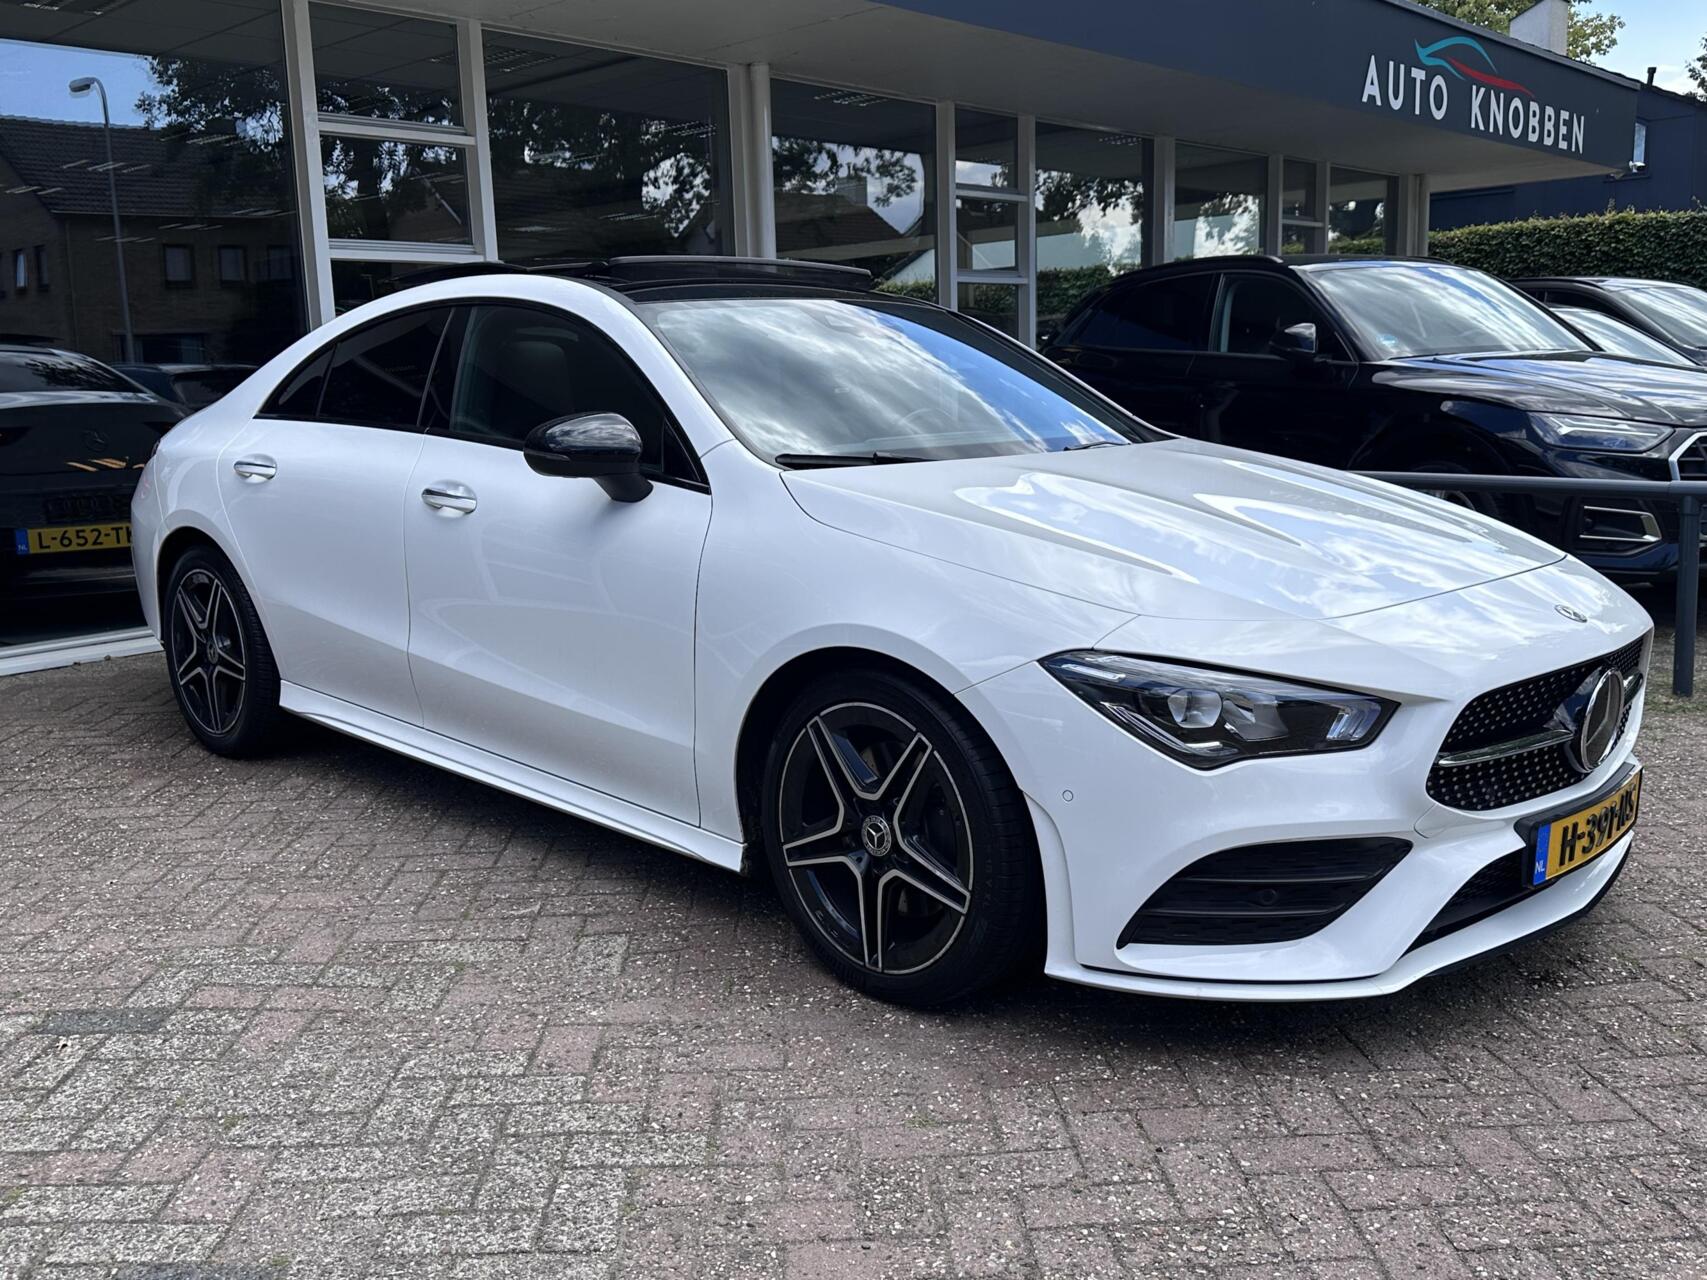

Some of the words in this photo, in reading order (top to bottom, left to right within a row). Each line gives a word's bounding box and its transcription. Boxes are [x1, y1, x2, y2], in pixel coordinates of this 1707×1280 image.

[1362, 55, 1448, 120] AUTO
[1471, 85, 1585, 153] KNOBBEN
[1534, 861, 1545, 873] NL
